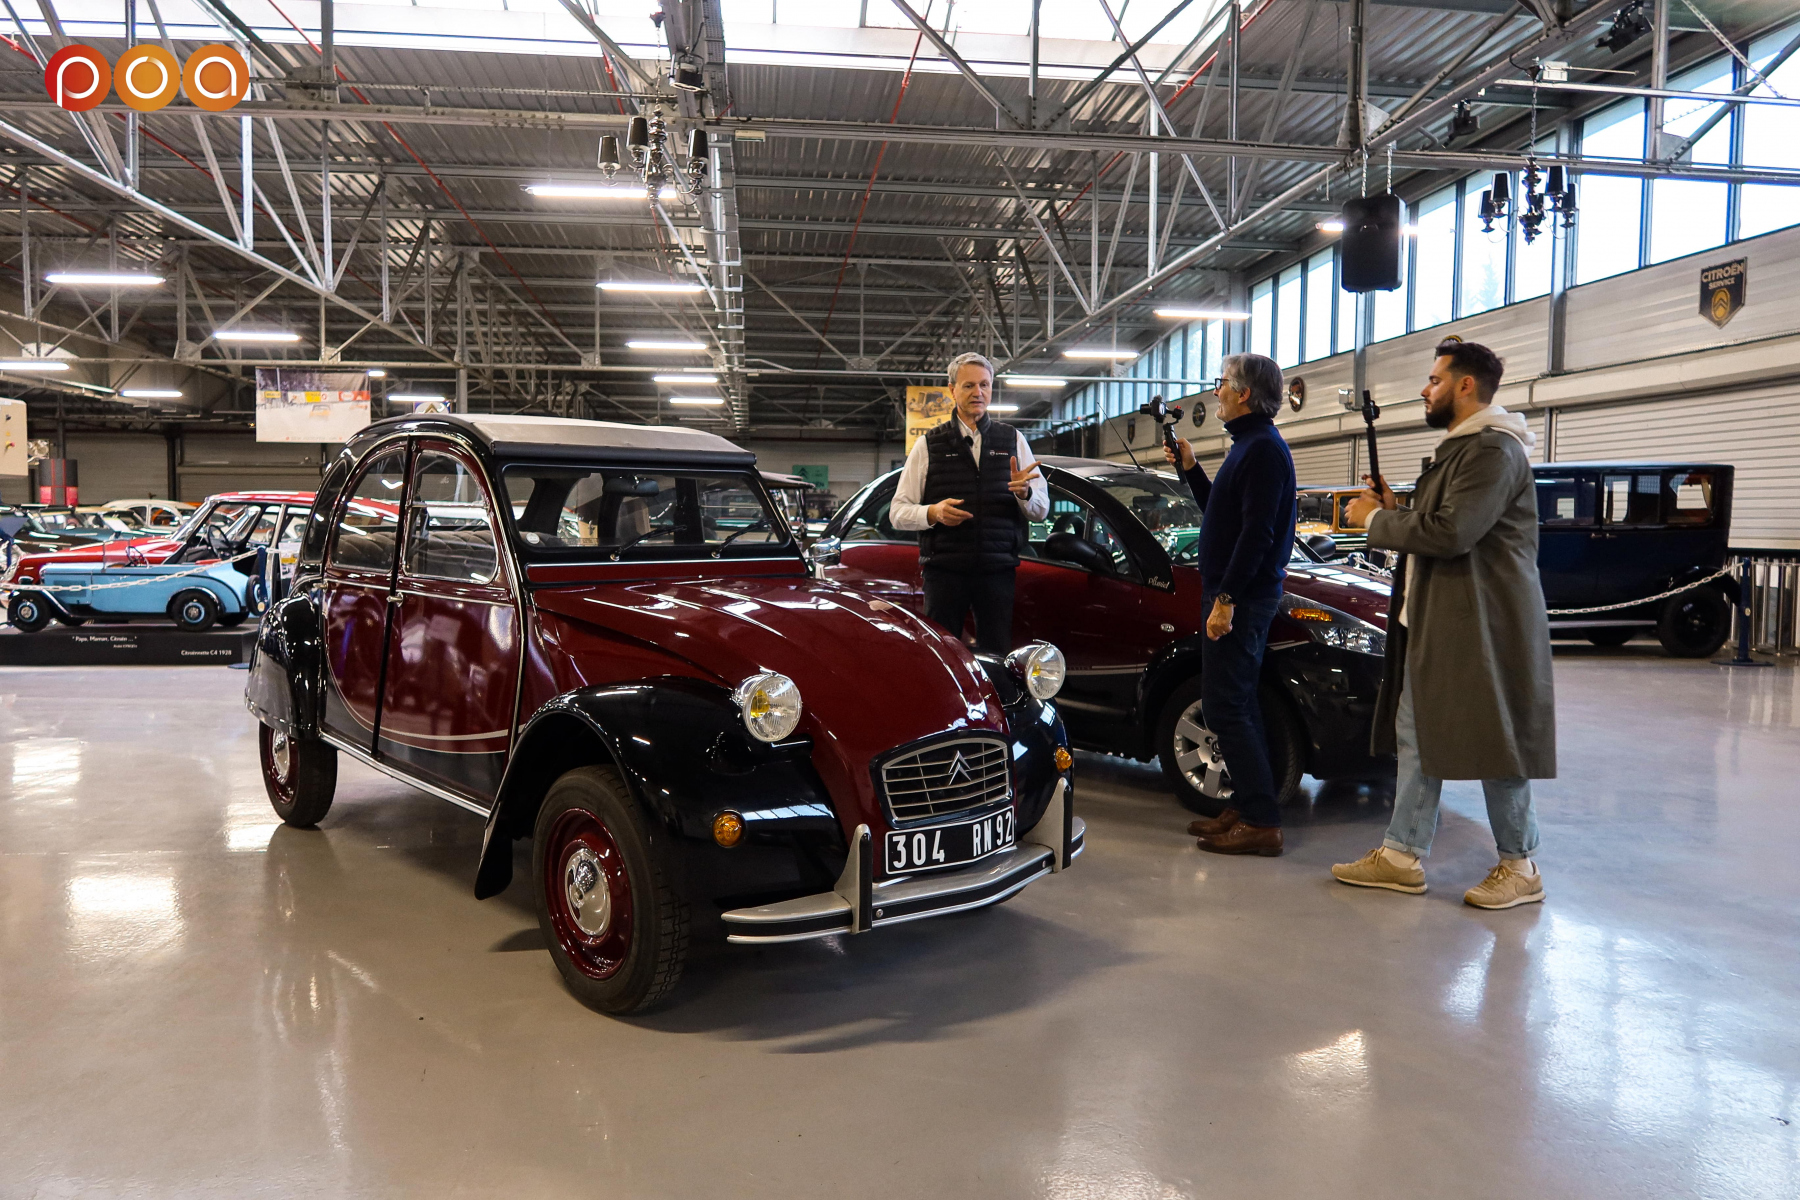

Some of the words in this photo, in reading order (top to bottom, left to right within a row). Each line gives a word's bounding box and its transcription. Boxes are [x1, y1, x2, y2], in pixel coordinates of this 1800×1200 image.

[1702, 263, 1744, 283] CITROËN
[1709, 277, 1735, 290] SERVICE
[892, 830, 945, 868] 304
